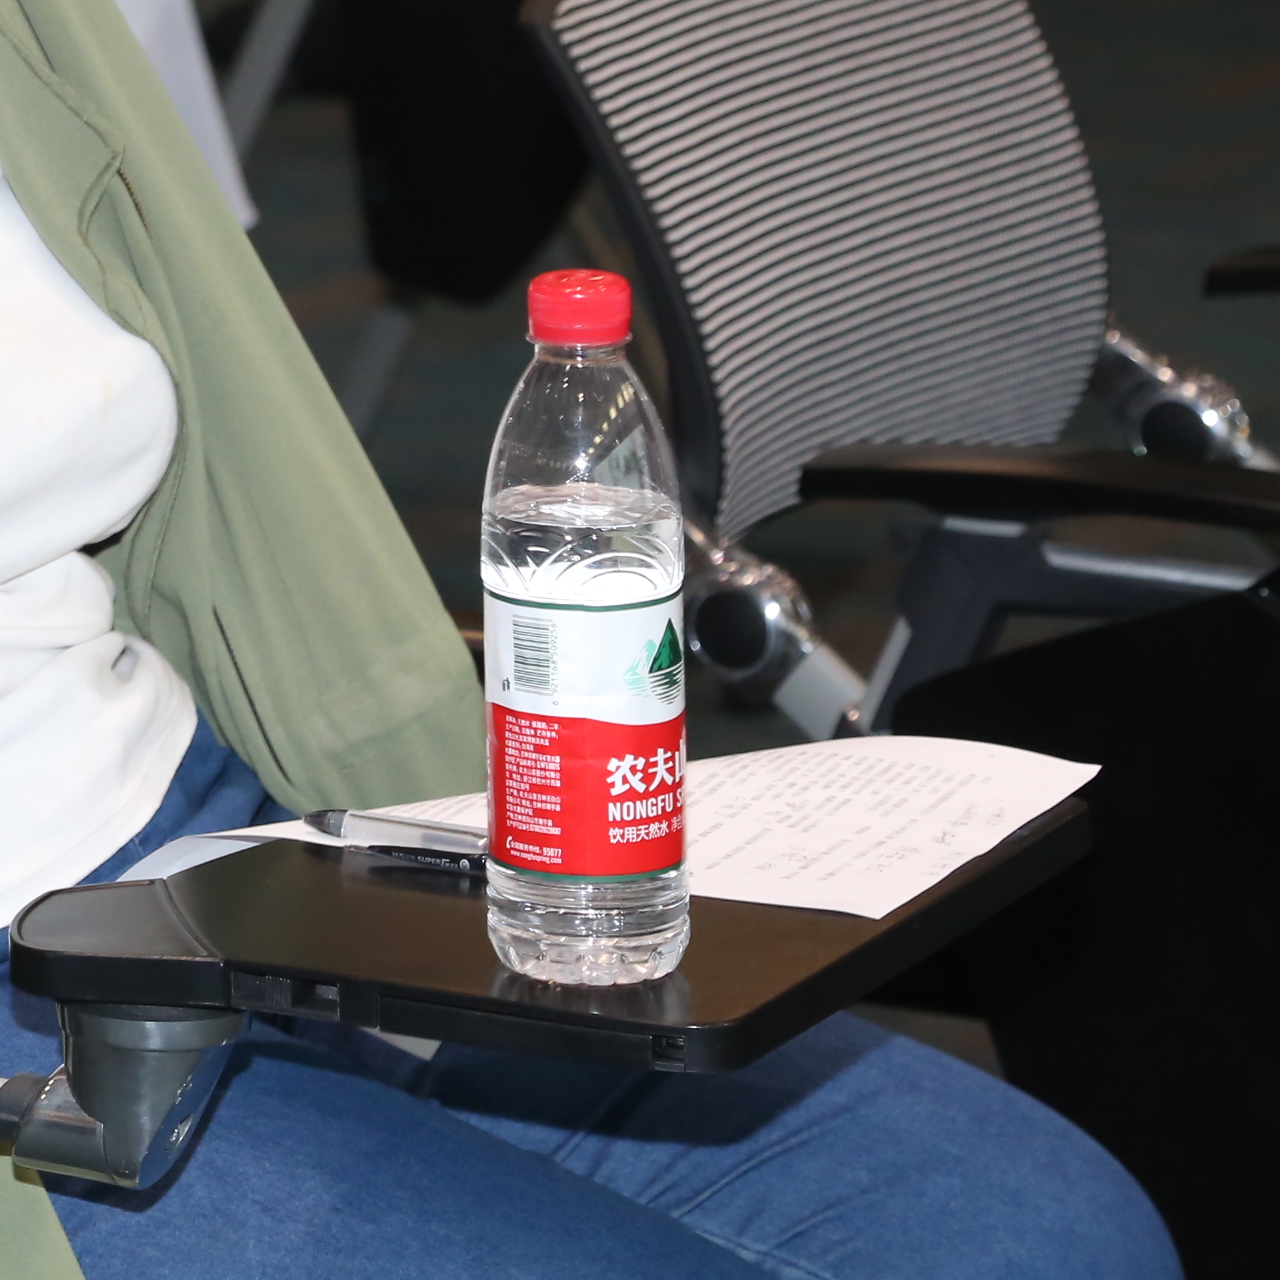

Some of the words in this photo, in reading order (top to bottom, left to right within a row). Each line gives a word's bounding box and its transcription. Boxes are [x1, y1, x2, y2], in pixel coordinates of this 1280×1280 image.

[607, 792, 673, 822] NONGFU
[608, 820, 670, 845] 饮用天然水
[542, 847, 562, 858] 95077
